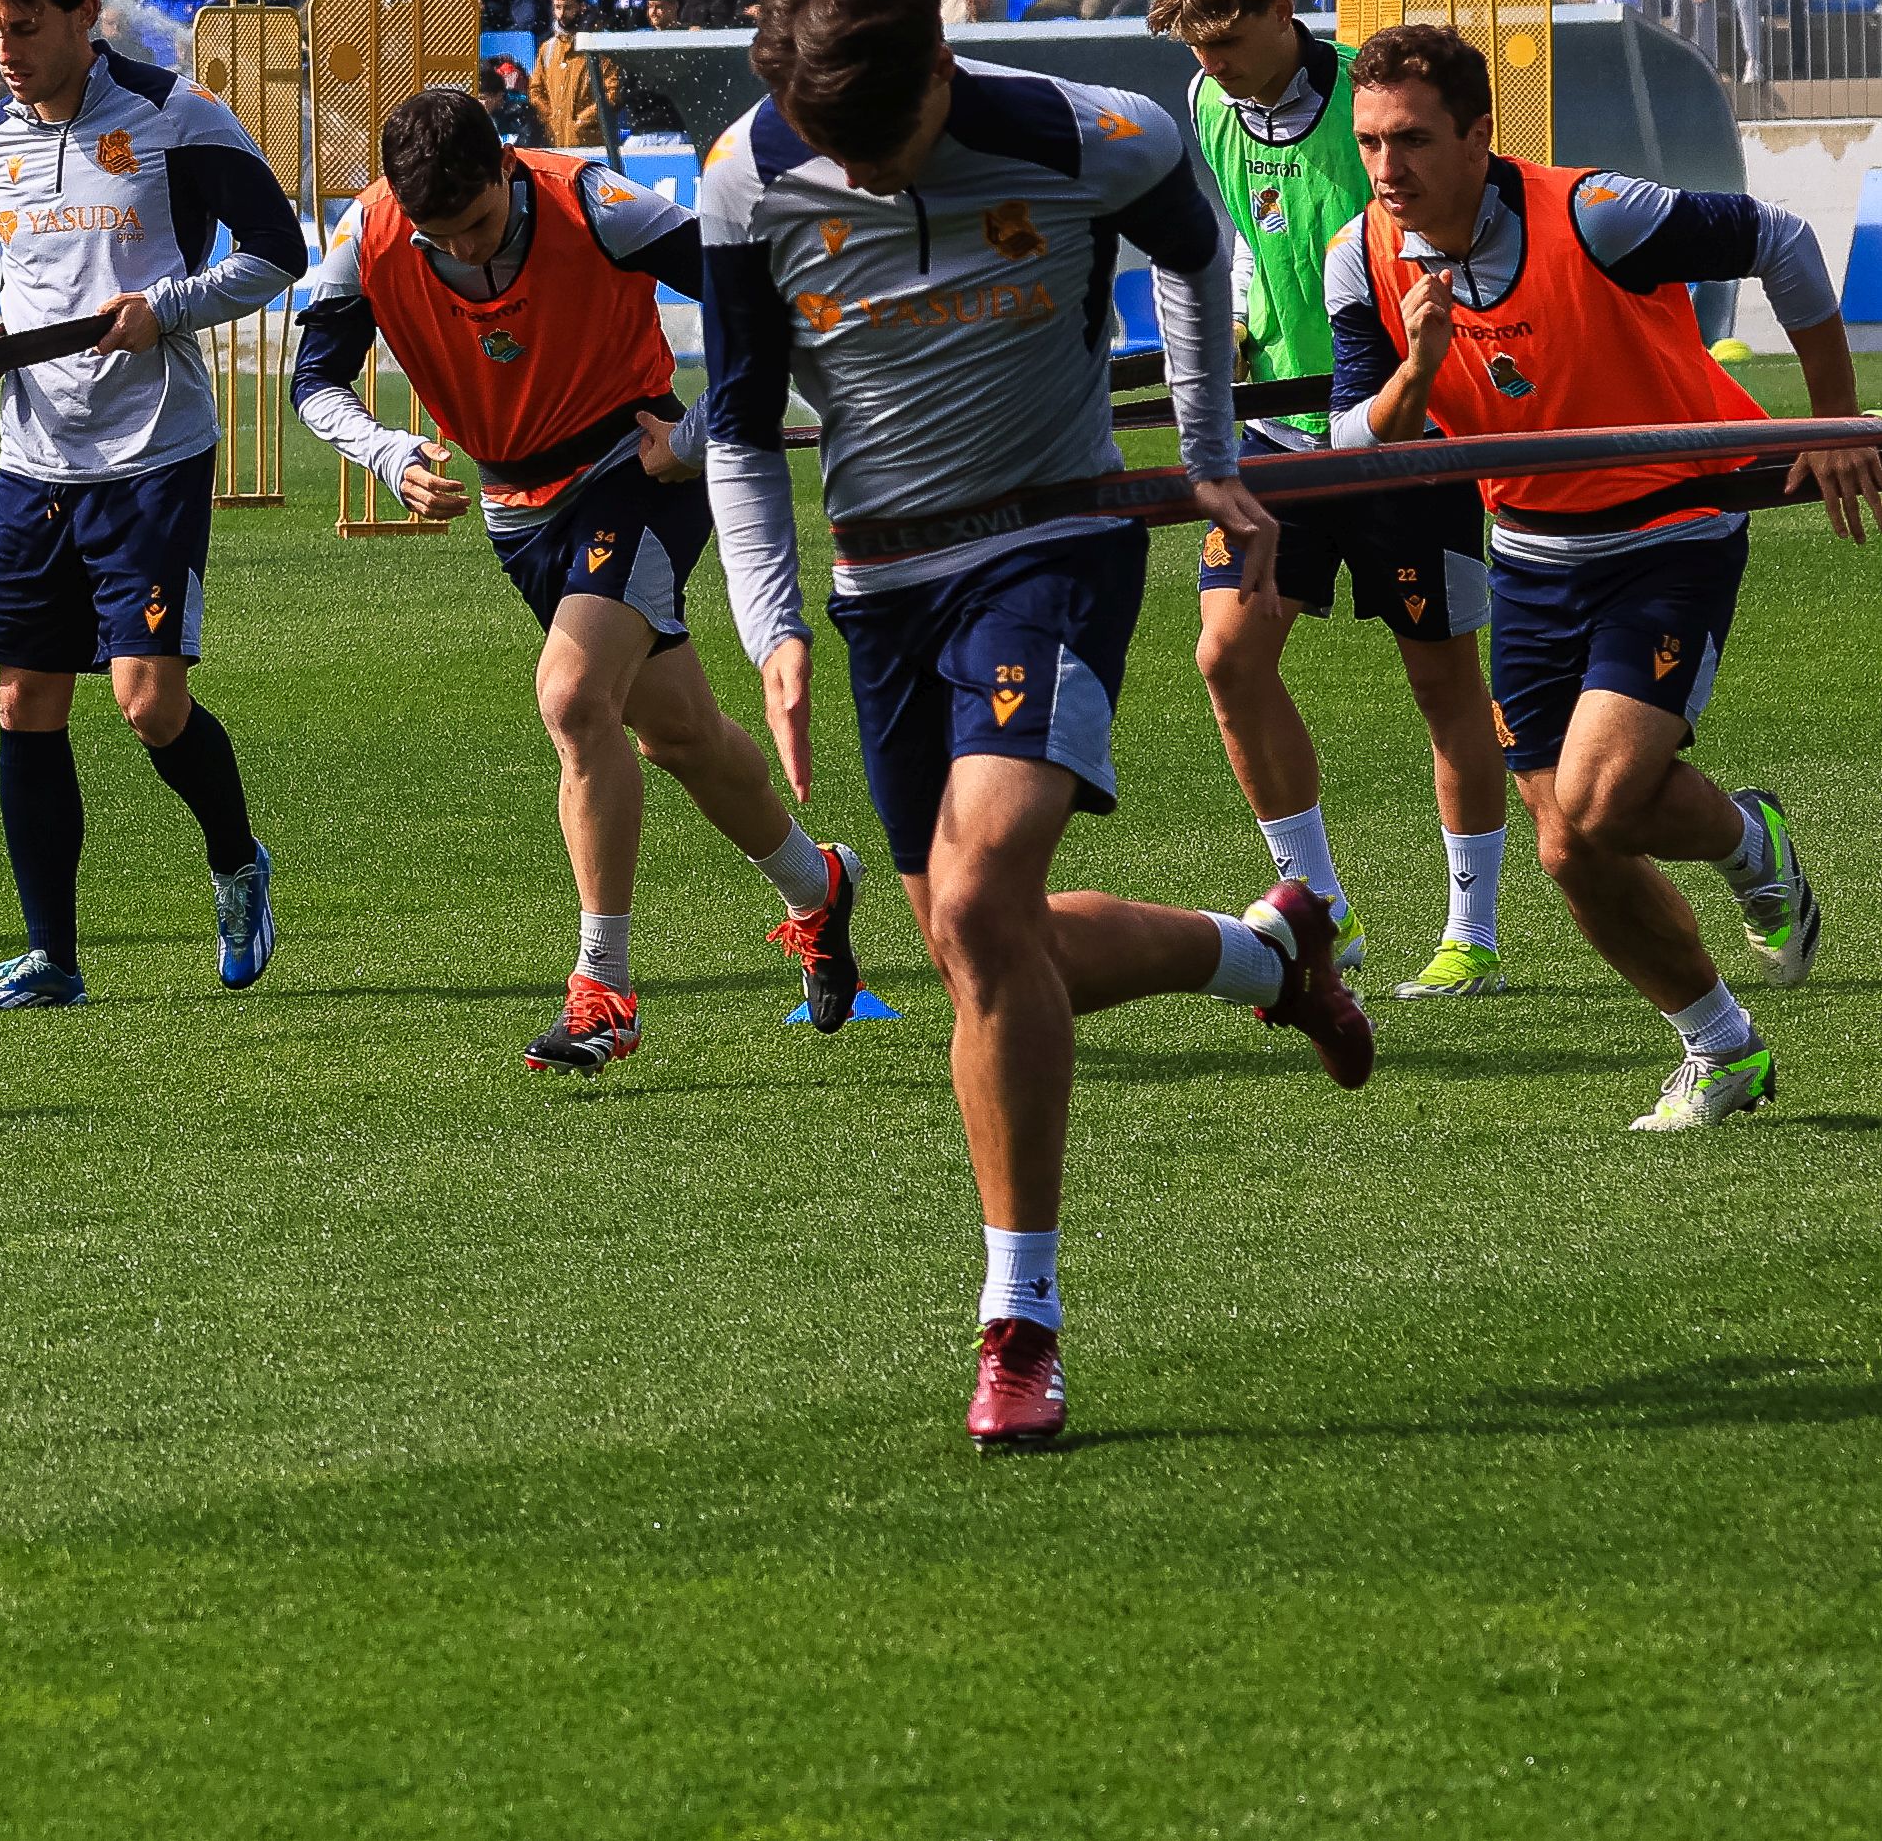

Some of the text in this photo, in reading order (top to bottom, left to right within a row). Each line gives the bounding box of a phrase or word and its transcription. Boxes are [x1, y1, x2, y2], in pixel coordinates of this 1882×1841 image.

[24, 205, 145, 235] YASUDA
[116, 231, 145, 244] group
[1452, 321, 1533, 340] macron
[594, 530, 617, 544] 34
[1397, 568, 1418, 582] 22
[150, 585, 162, 599] 2
[995, 665, 1026, 683] 26
